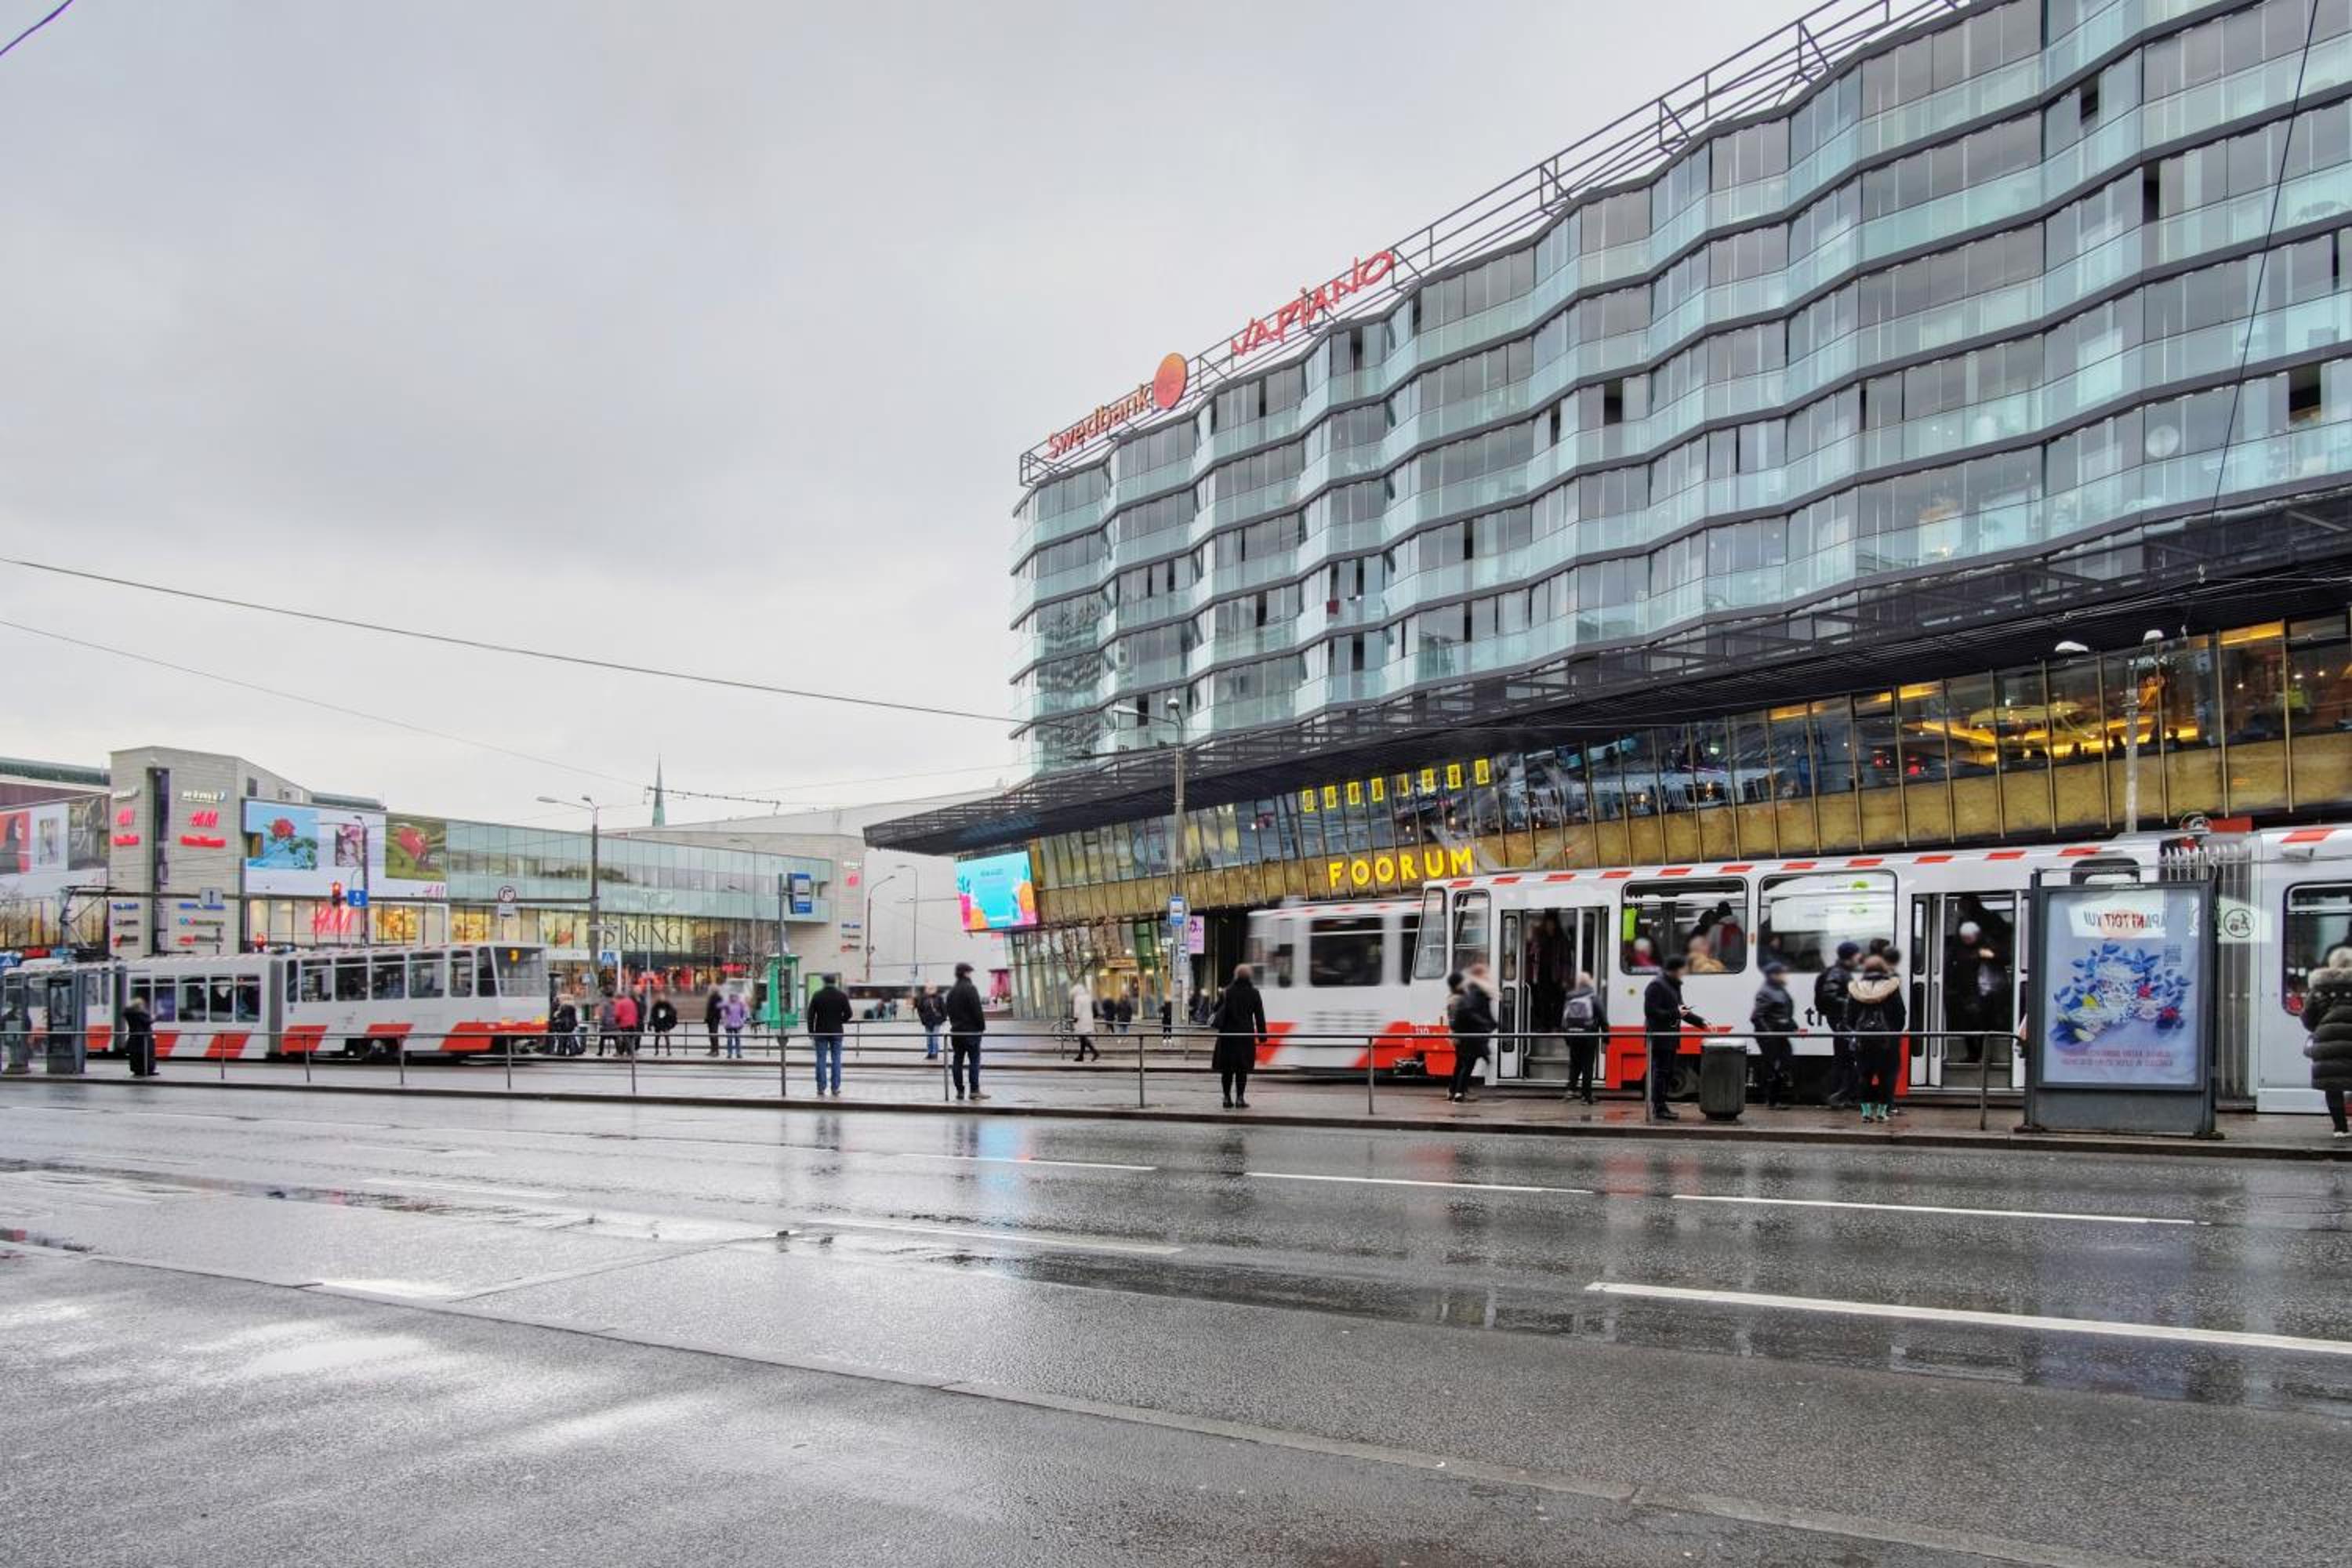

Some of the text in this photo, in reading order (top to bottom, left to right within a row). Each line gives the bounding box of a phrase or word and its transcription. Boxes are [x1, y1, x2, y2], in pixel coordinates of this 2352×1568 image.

[1230, 250, 1395, 357] VAPIANO
[1047, 384, 1153, 459] Swedbank
[1328, 846, 1474, 888] FOORUM
